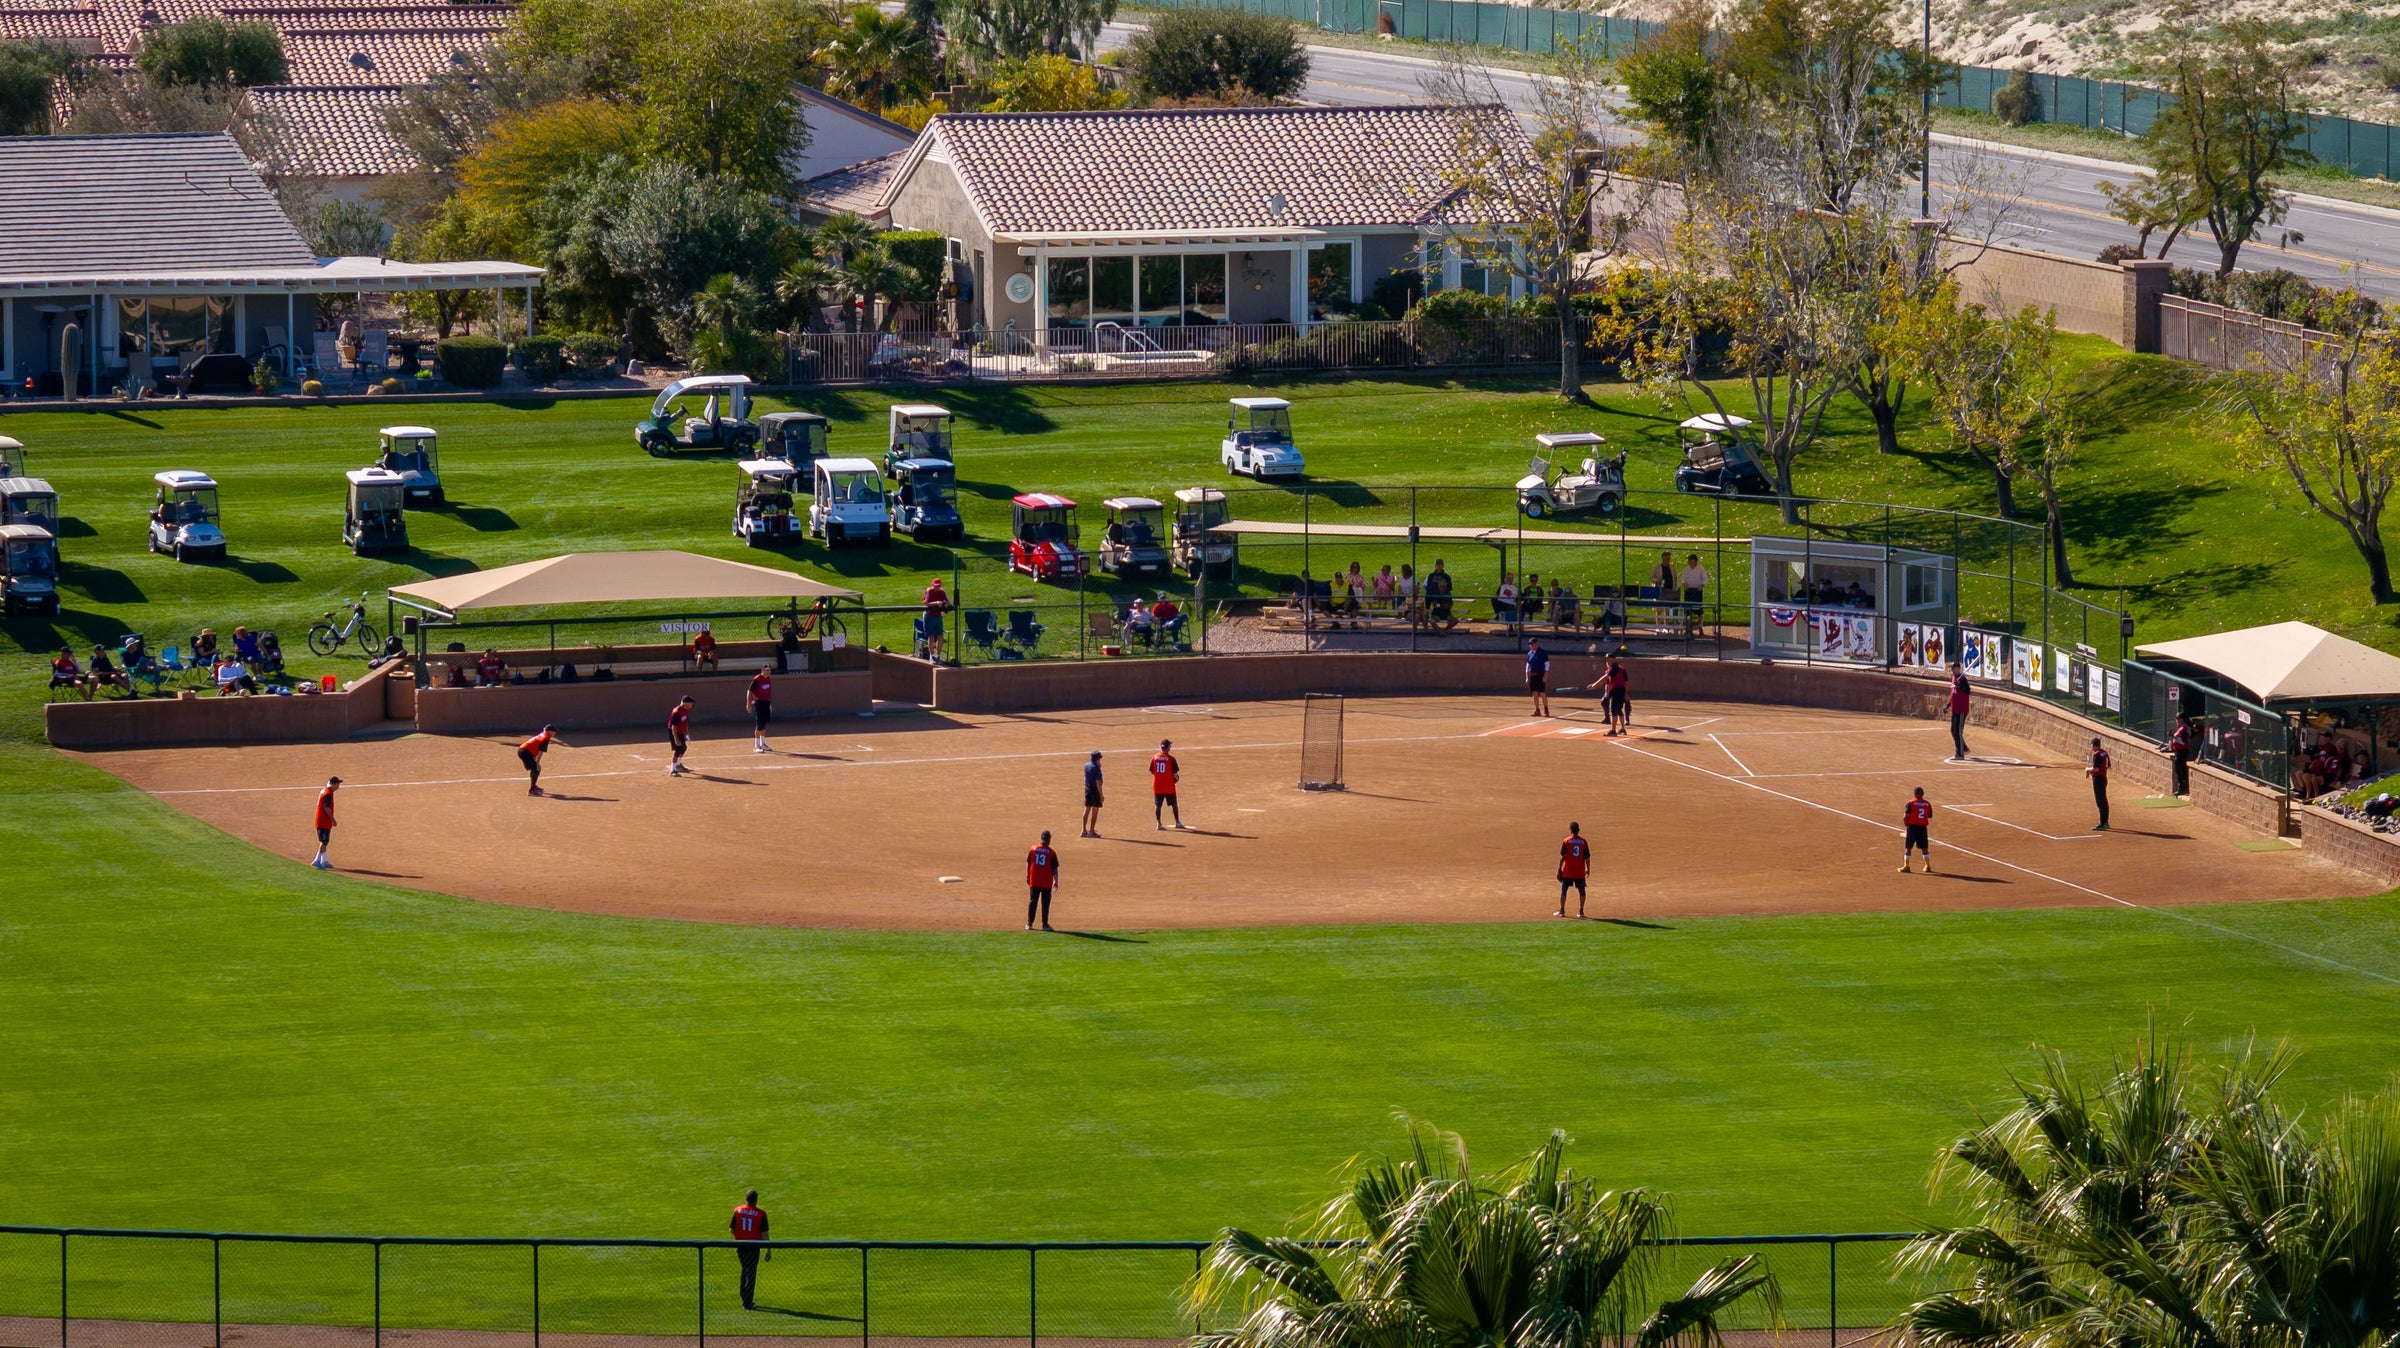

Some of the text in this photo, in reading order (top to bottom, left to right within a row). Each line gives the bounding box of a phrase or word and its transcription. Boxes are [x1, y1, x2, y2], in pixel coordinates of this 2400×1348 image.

[662, 622, 709, 632] VISITOR
[1156, 762, 1166, 773] 10
[1918, 808, 1925, 819] 2
[1573, 845, 1580, 857] 3
[1035, 853, 1046, 866] 13
[741, 1217, 752, 1232] 11
